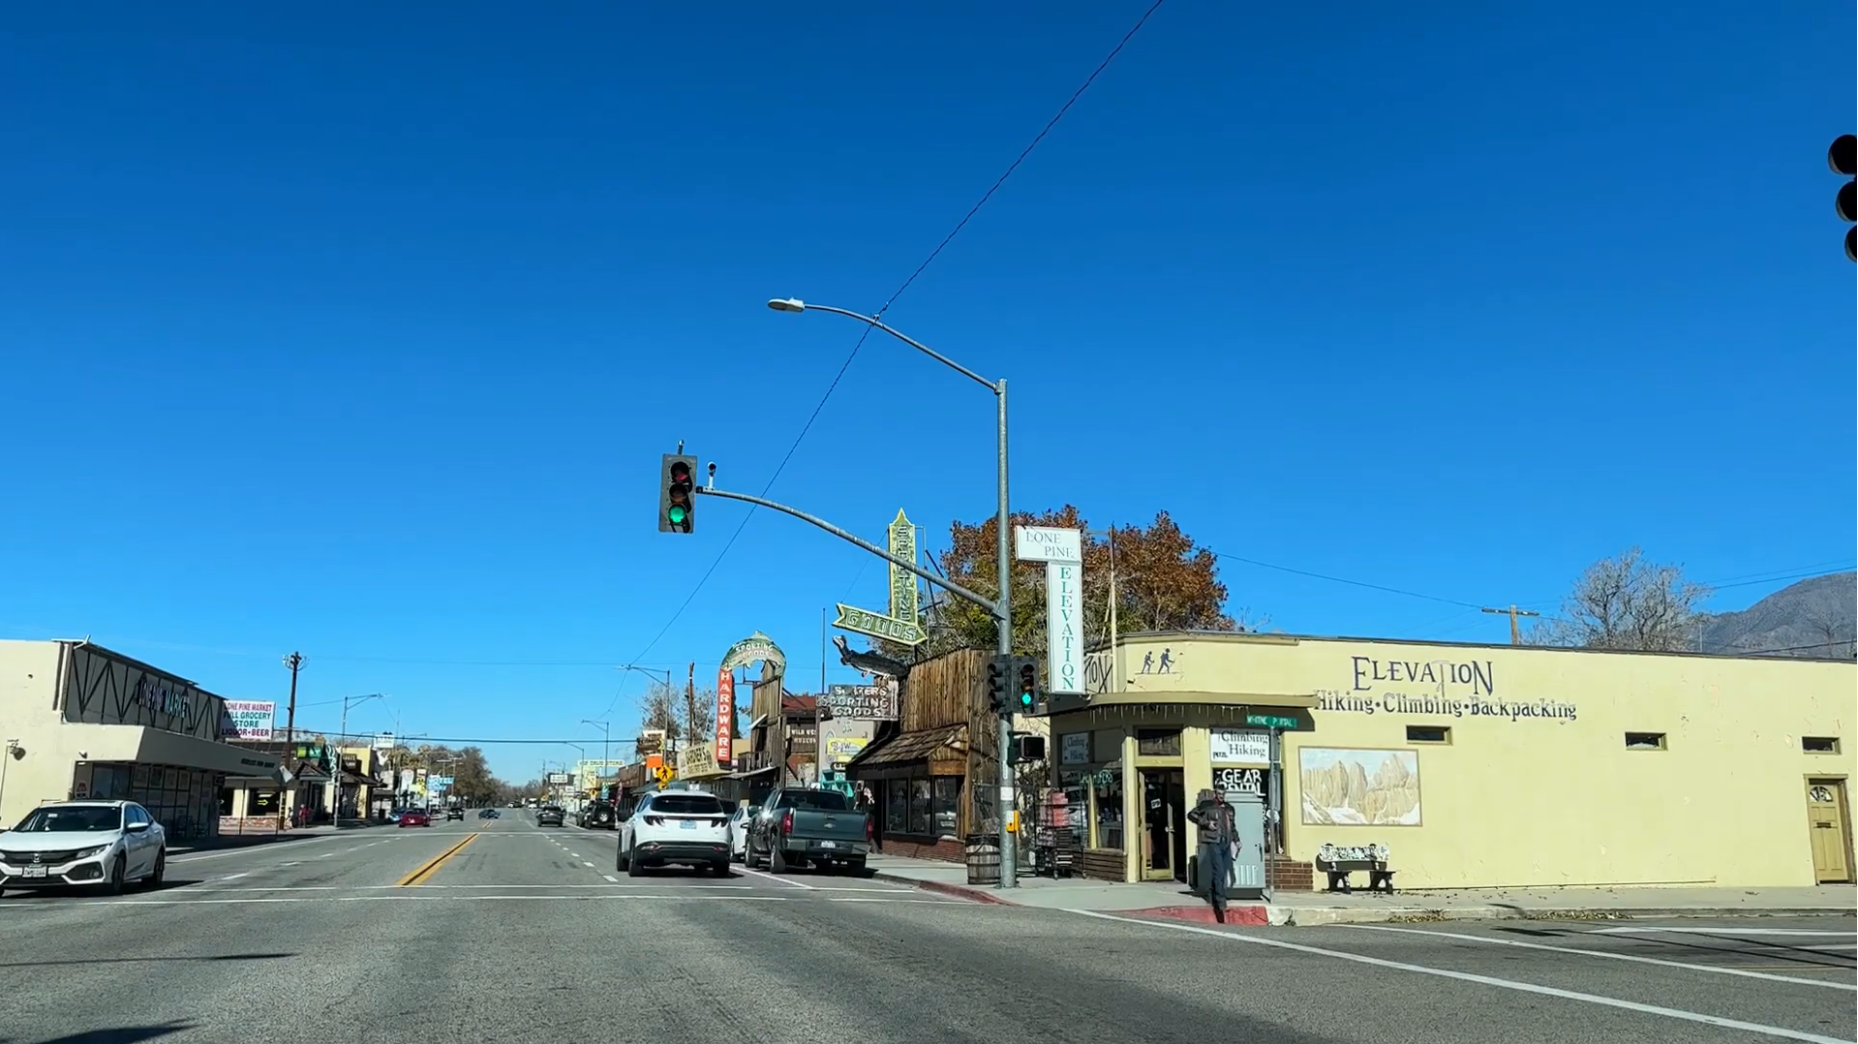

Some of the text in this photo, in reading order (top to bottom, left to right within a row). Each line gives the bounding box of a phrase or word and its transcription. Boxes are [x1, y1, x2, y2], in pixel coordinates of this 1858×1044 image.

[1026, 531, 1061, 544] LONE
[1044, 546, 1075, 558] PINE
[846, 610, 917, 641] GOODS
[1059, 567, 1074, 690] ELEVATION
[832, 706, 881, 717] GOODS
[1314, 689, 1577, 722] Hiking Climbing Backpacking
[241, 711, 271, 719] GROCERY
[718, 673, 730, 757] HARDWARE
[234, 720, 259, 728] STORE
[1221, 730, 1268, 744] Climbing
[1229, 743, 1266, 758] Hiking
[1222, 769, 1262, 783] GEAR
